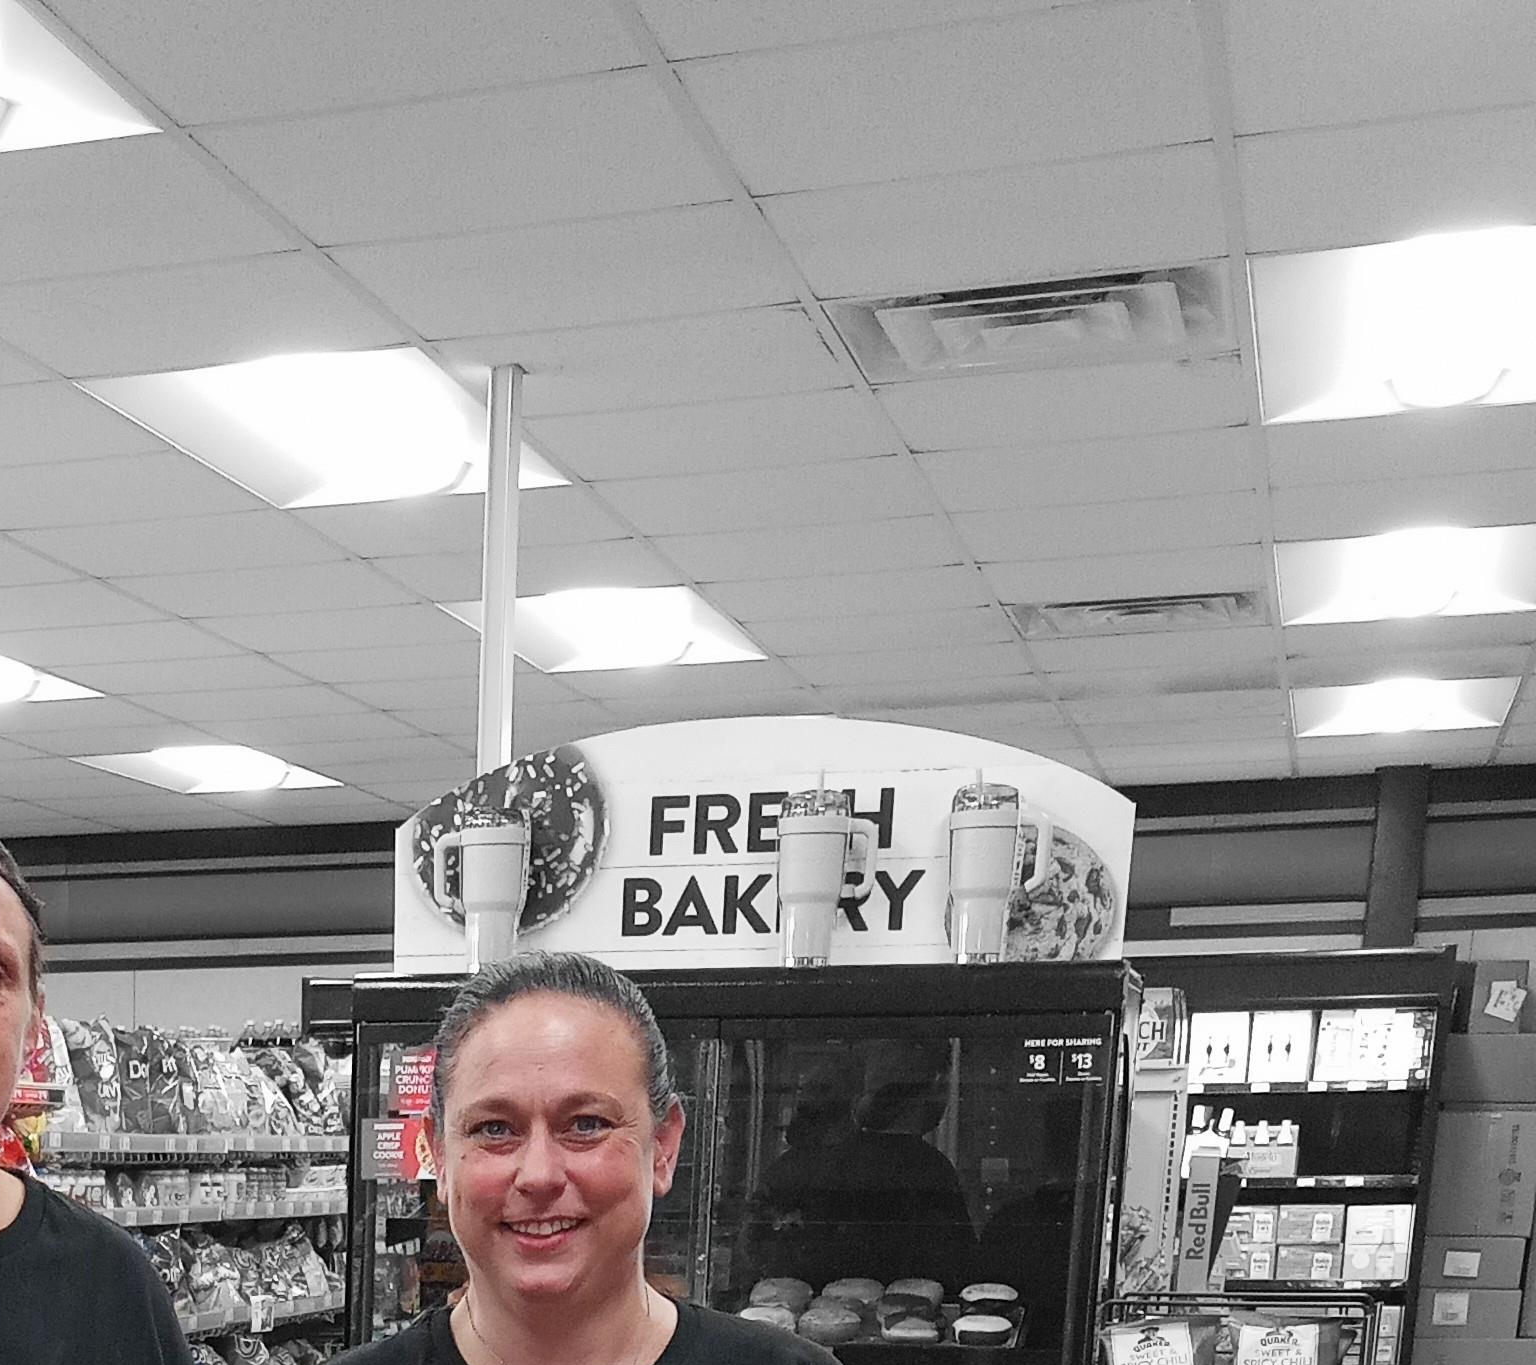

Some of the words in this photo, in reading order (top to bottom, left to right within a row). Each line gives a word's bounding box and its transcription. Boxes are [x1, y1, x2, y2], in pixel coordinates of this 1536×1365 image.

[649, 787, 895, 856] FREH
[622, 869, 926, 936] BAKRY
[395, 1075, 432, 1085] CRUNC
